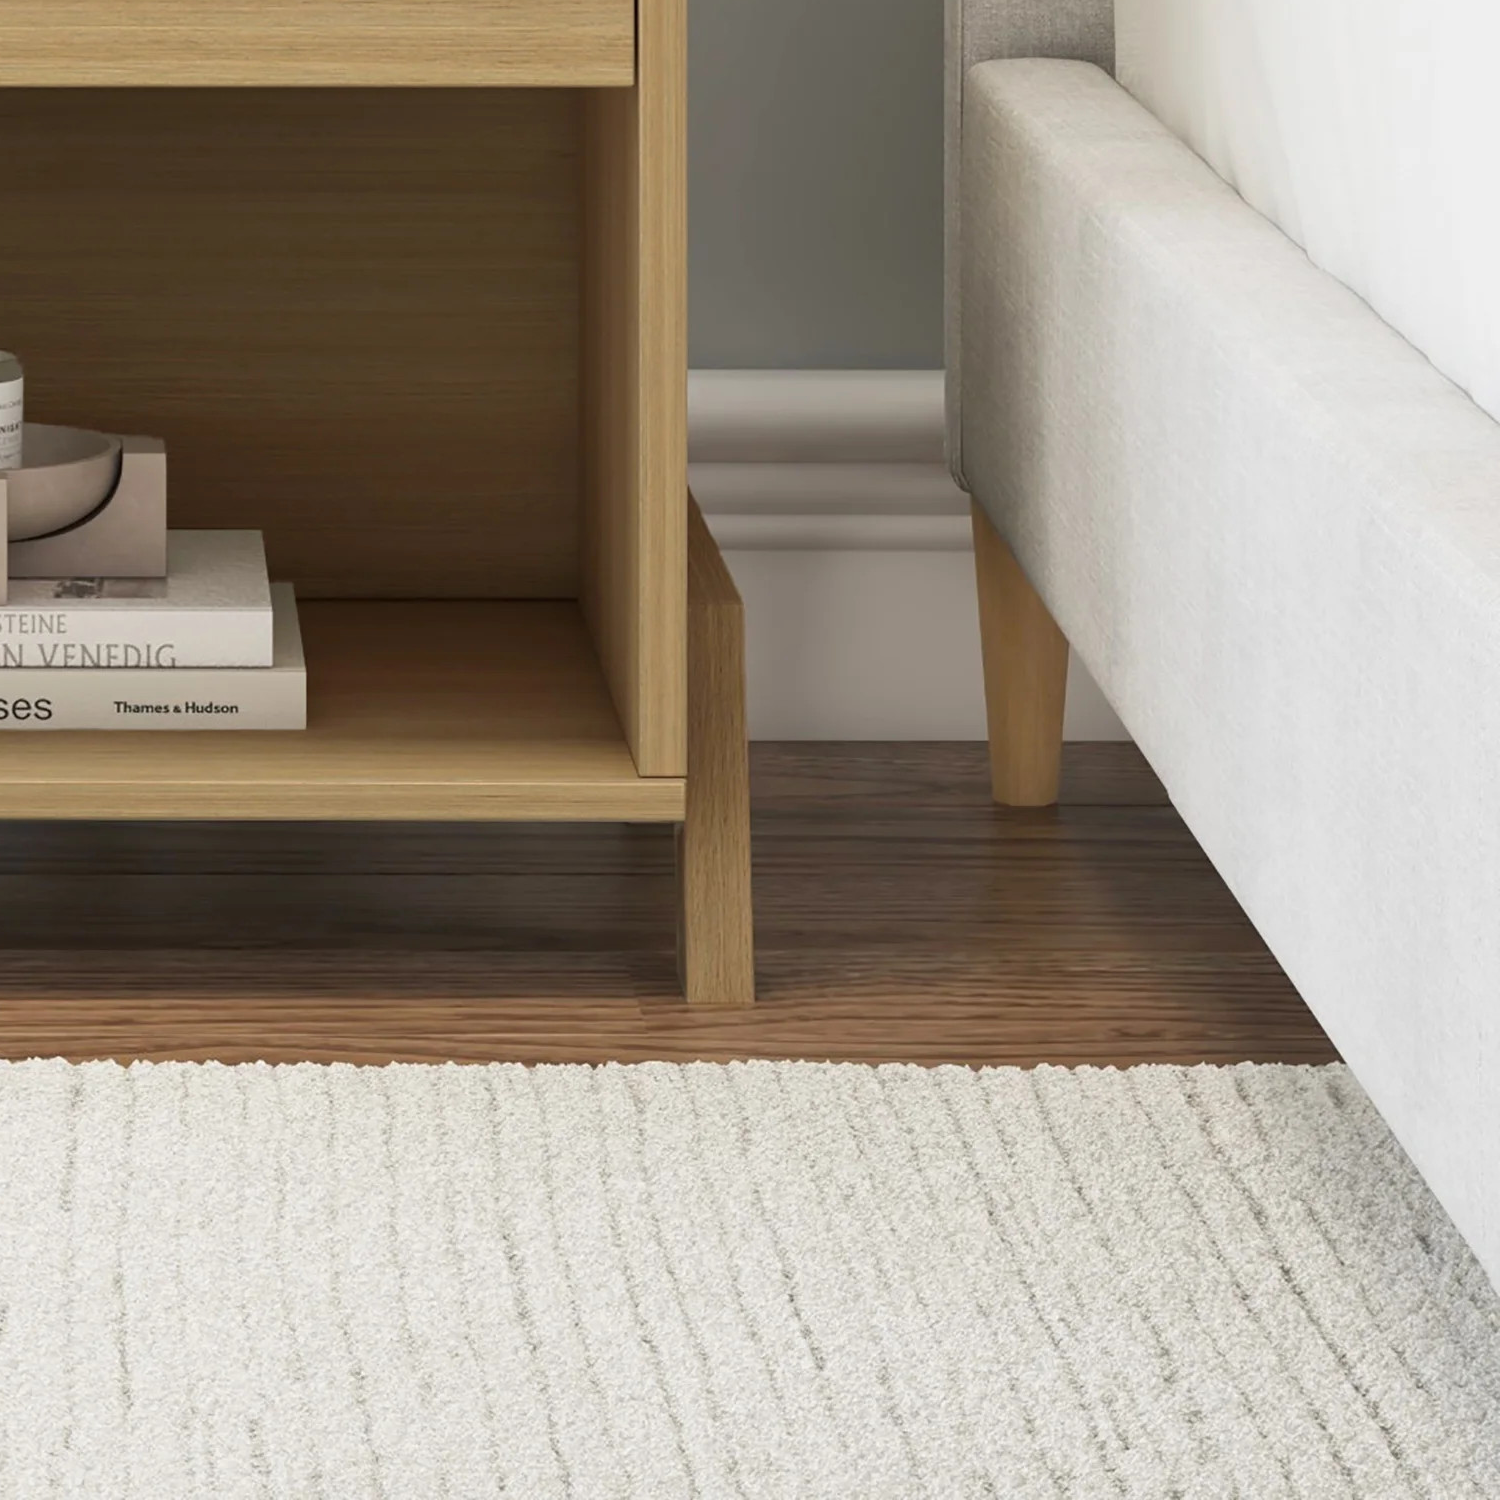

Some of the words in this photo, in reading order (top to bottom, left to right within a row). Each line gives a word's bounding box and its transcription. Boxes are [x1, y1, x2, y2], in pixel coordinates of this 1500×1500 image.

[37, 643, 177, 667] VENEDIG
[113, 700, 170, 714] Thames
[172, 705, 182, 714] &
[184, 701, 240, 714] Hudson
